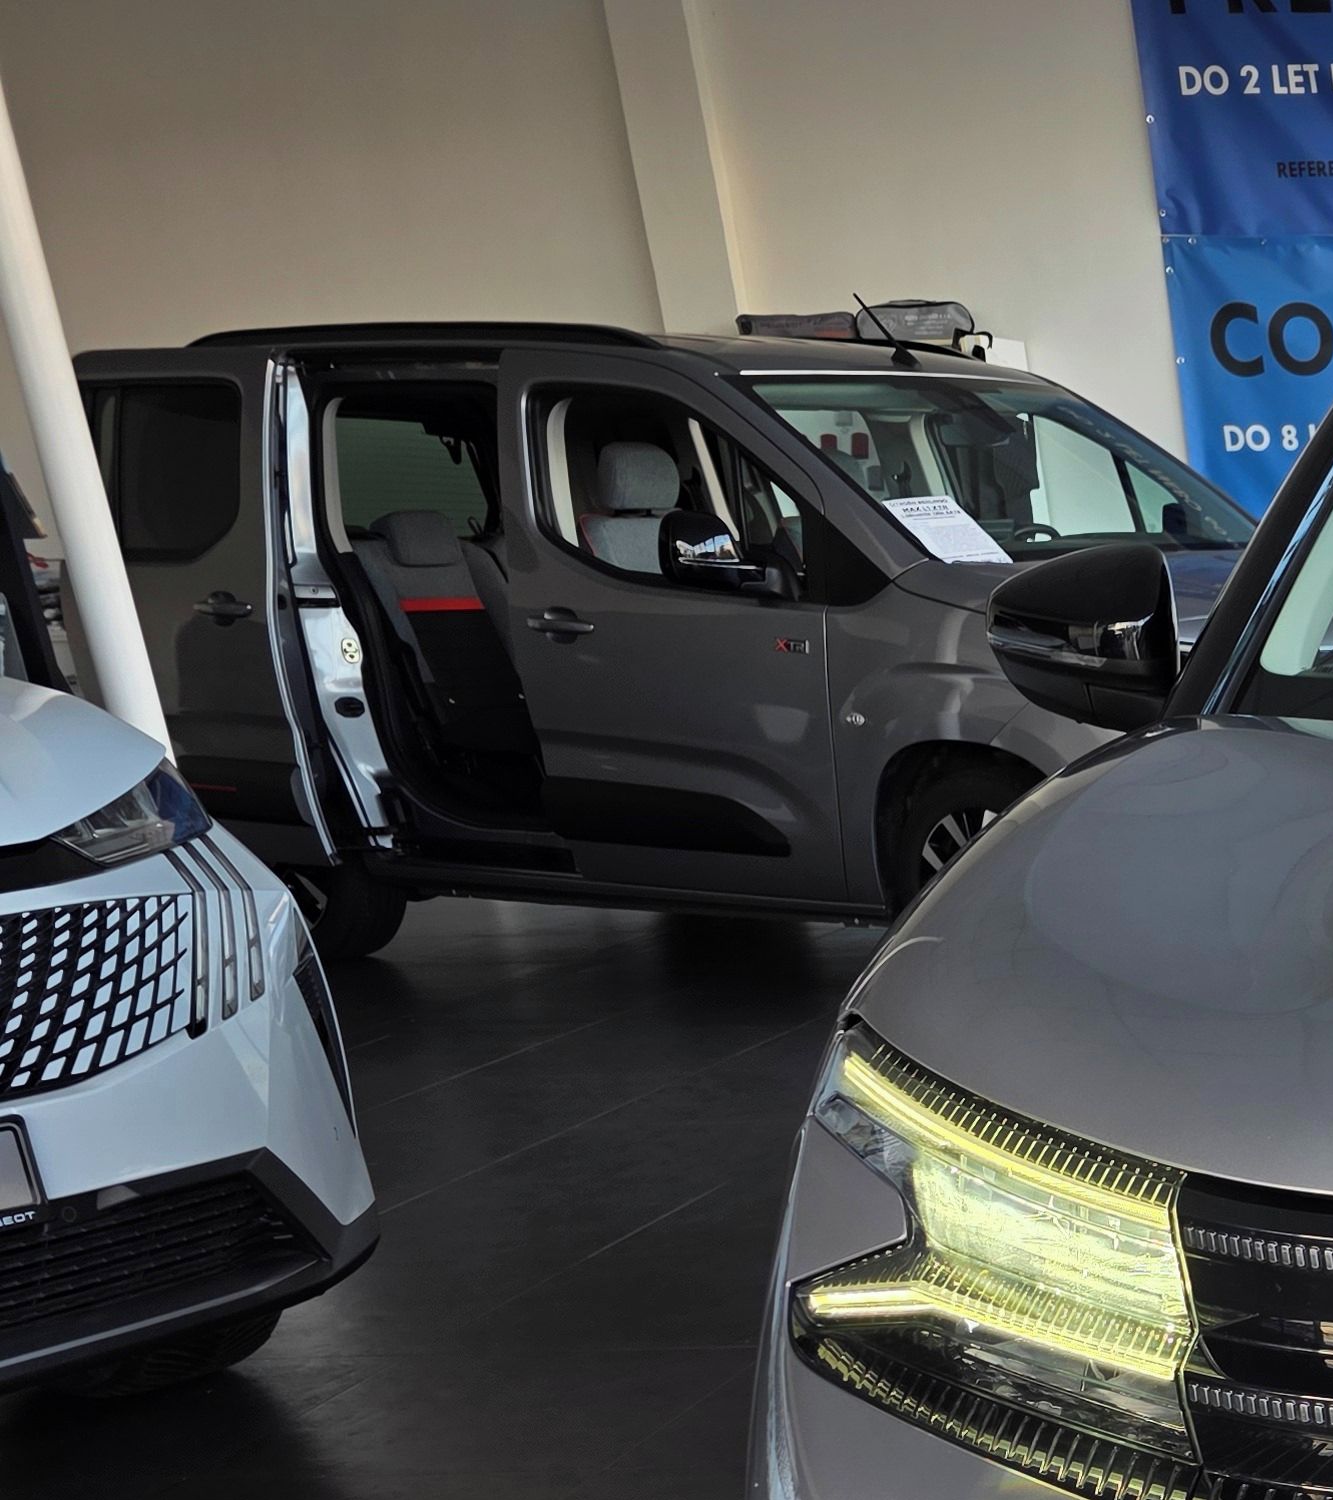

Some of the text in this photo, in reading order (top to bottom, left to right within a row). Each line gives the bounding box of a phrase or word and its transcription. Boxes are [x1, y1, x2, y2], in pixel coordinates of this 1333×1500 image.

[1179, 64, 1231, 97] DO
[1239, 64, 1262, 95] 2
[1272, 63, 1320, 96] LET
[1223, 424, 1271, 453] DO
[1281, 424, 1300, 451] 8
[775, 638, 805, 653] XTR
[0, 1210, 36, 1227] EOT
